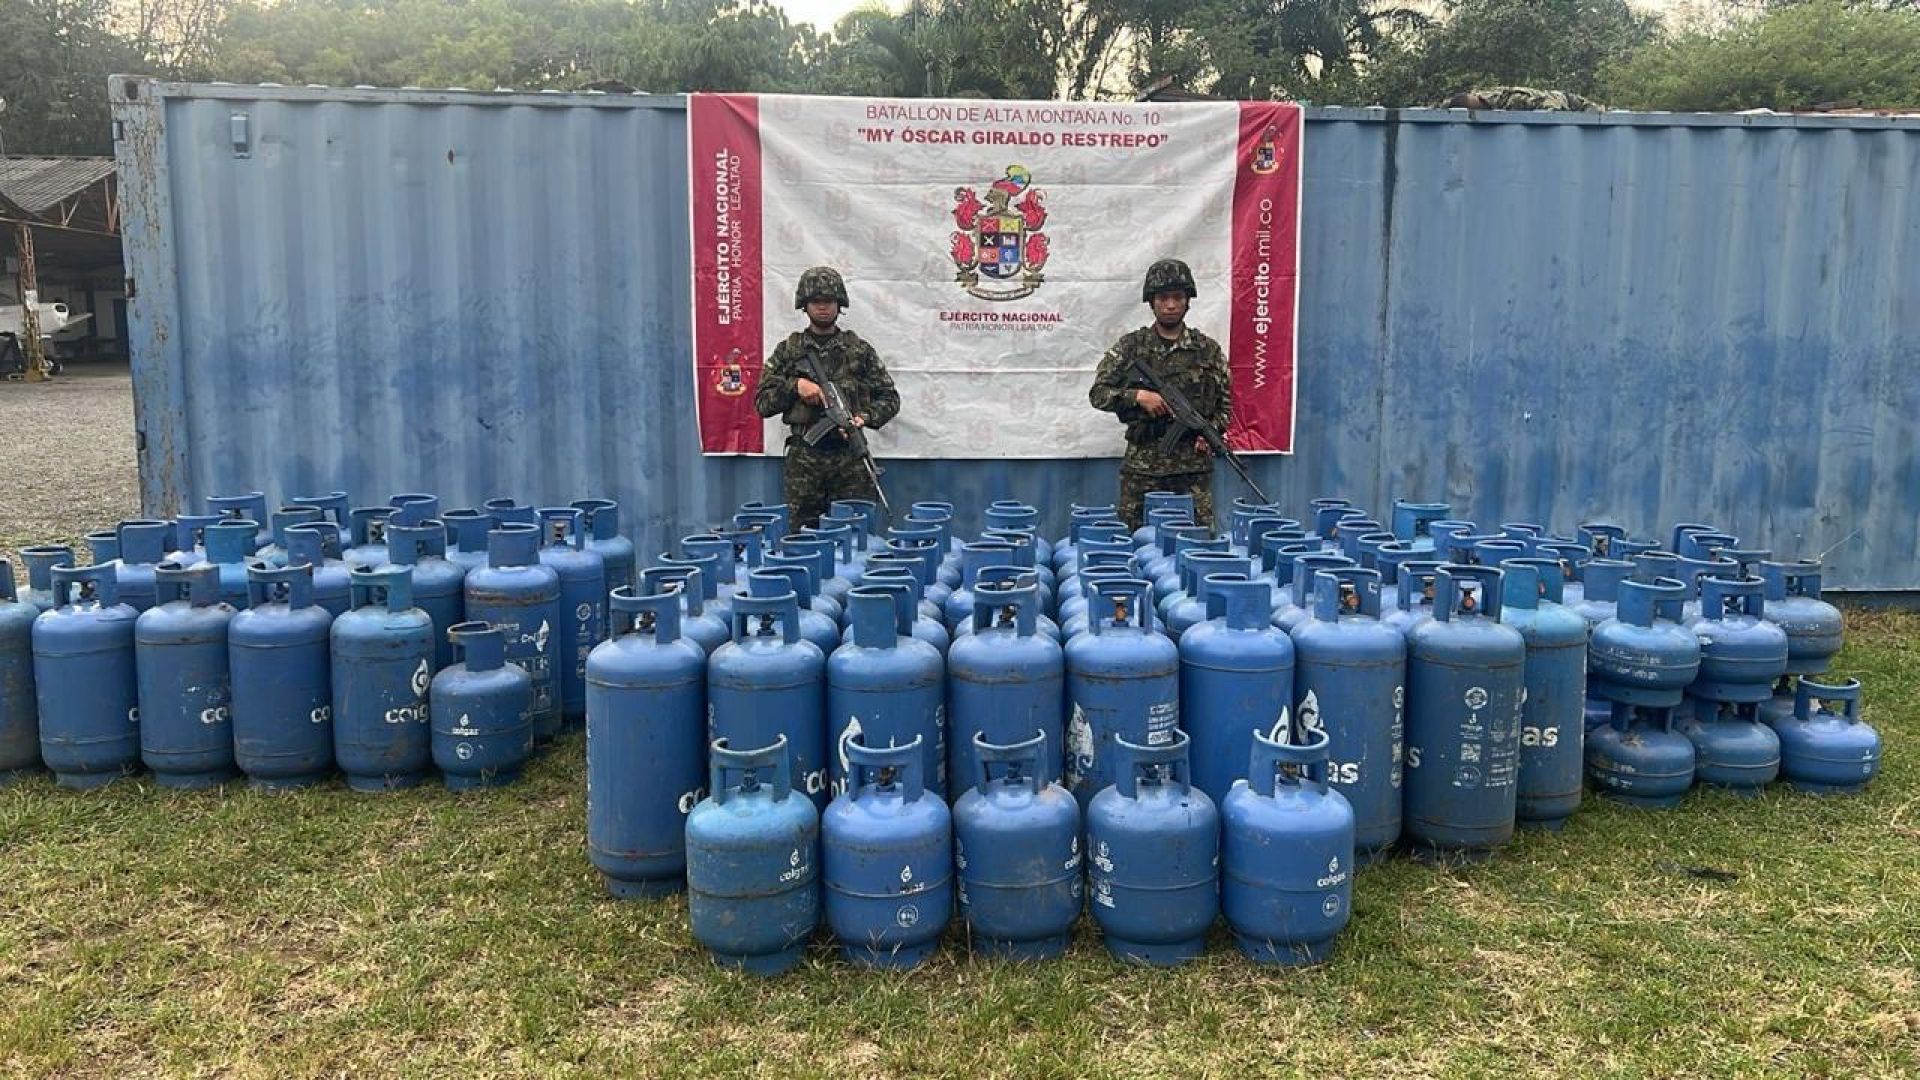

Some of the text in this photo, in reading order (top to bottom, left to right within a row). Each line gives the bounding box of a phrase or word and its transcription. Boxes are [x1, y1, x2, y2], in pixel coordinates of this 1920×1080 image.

[866, 104, 1160, 126] BATALLÓN DE ALTA MONTAÑA No. 10
[901, 125, 965, 144] ÓSCAR
[972, 131, 1055, 146] GIRALDO
[716, 148, 730, 325] EJÉRCITO NACIONAL
[730, 155, 742, 320] PATRIA HONOR LEALTAD
[1253, 198, 1273, 389] www.ejercito.mil.co
[940, 310, 1064, 322] EJÉRCITO NACIONAL
[950, 322, 1054, 332] PATRIA HONOR LEALTAD
